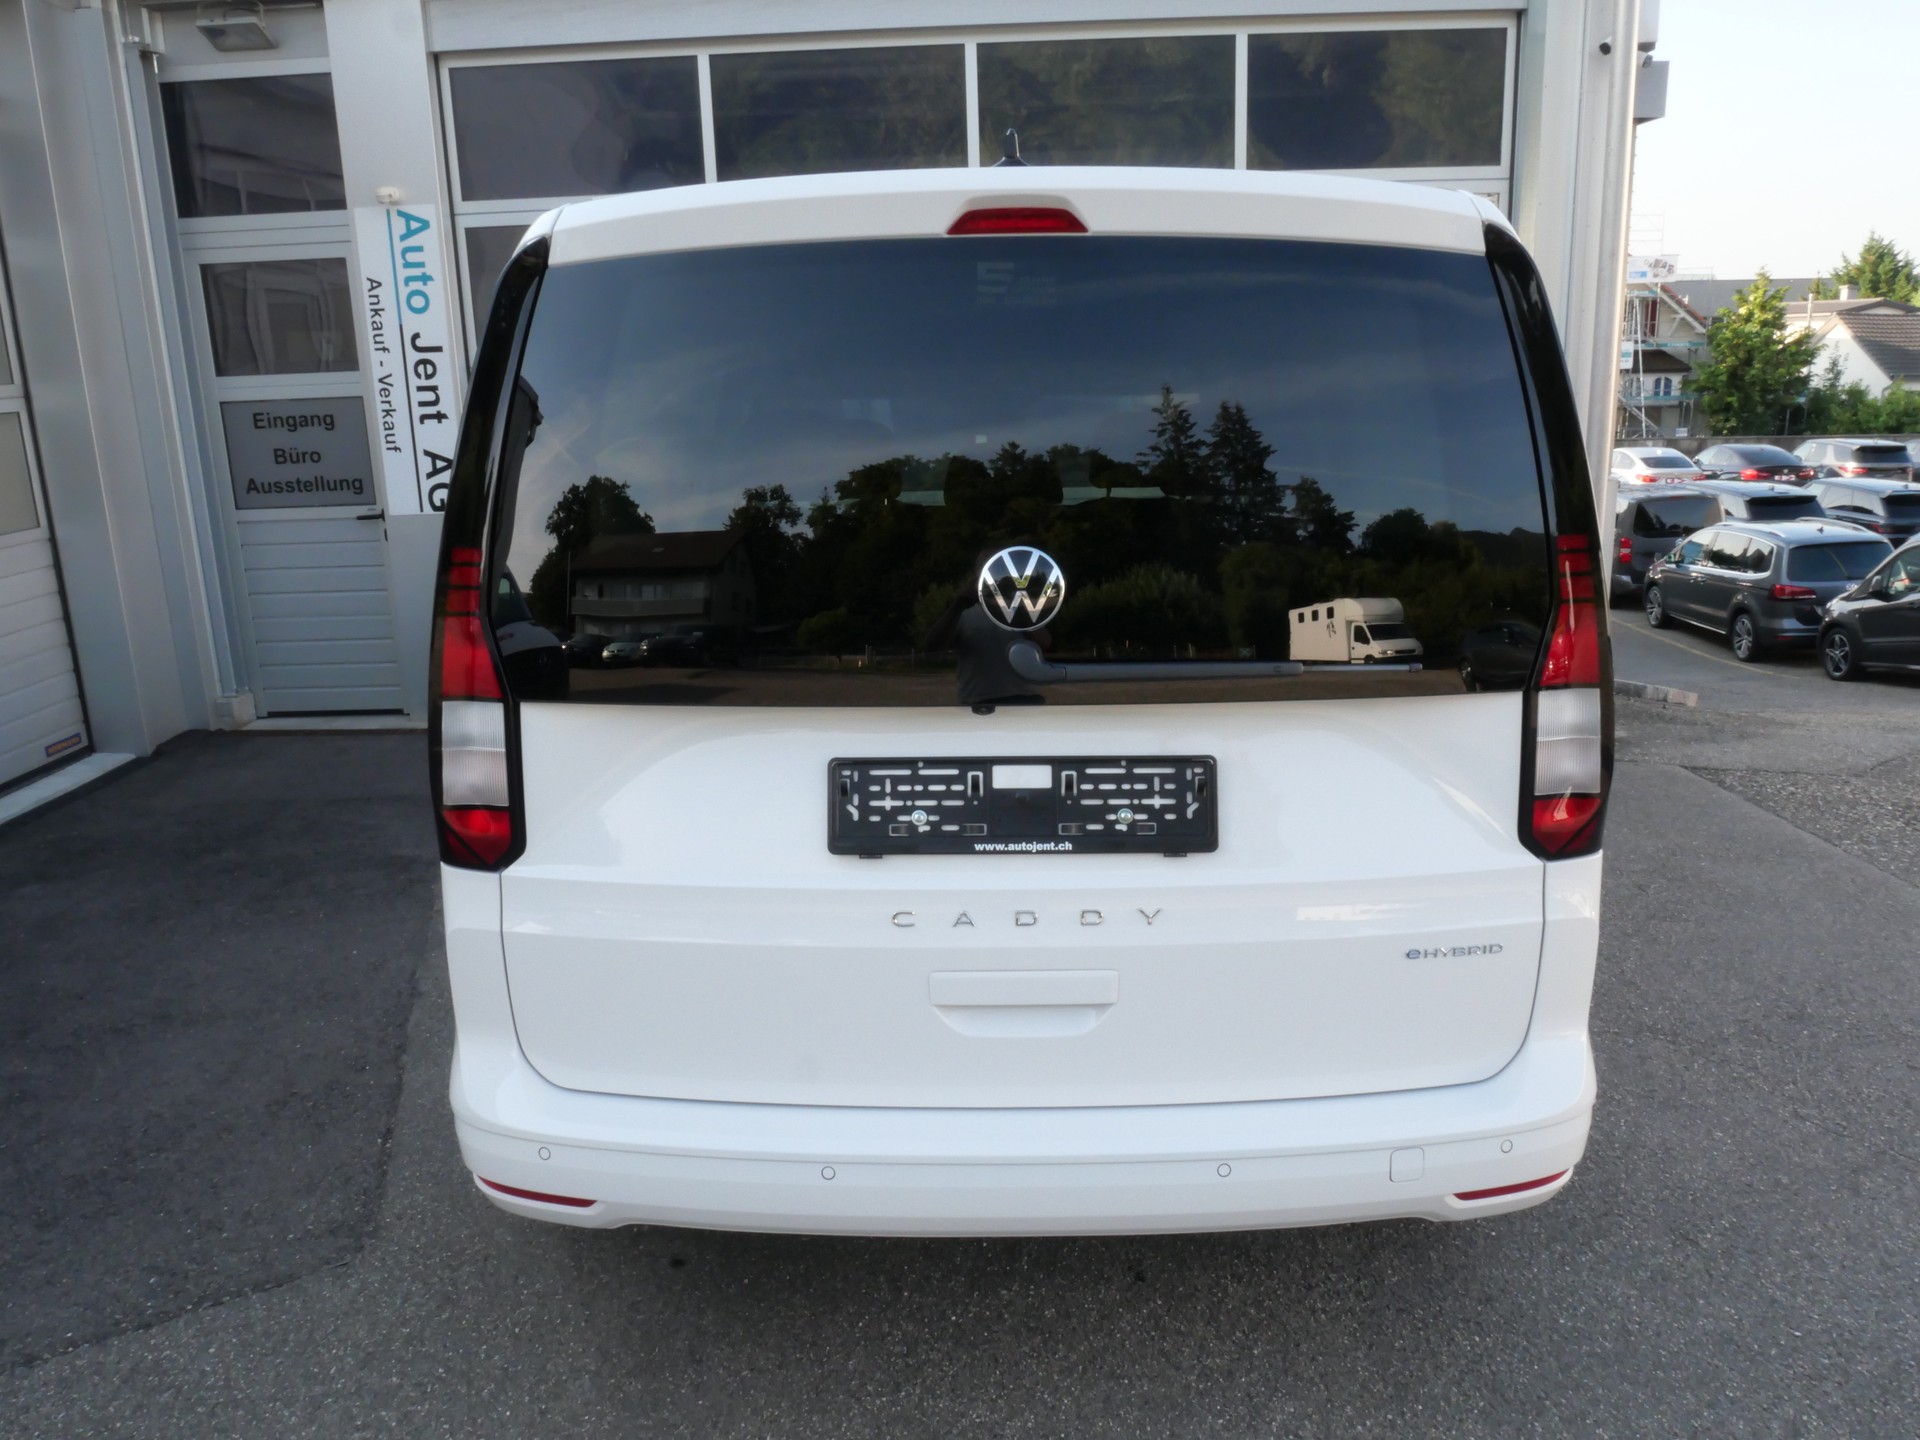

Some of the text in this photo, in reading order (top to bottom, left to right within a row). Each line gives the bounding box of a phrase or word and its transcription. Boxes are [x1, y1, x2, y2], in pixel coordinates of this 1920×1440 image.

[366, 276, 390, 354] Ankauf
[396, 208, 454, 513] Auto Jent AG
[252, 412, 335, 432] Eingang
[377, 373, 402, 453] Verkauf
[273, 447, 322, 465] Büro
[246, 475, 364, 495] Ausstellung
[974, 841, 1073, 853] www.autojent.ch
[891, 907, 1162, 928] CADDY
